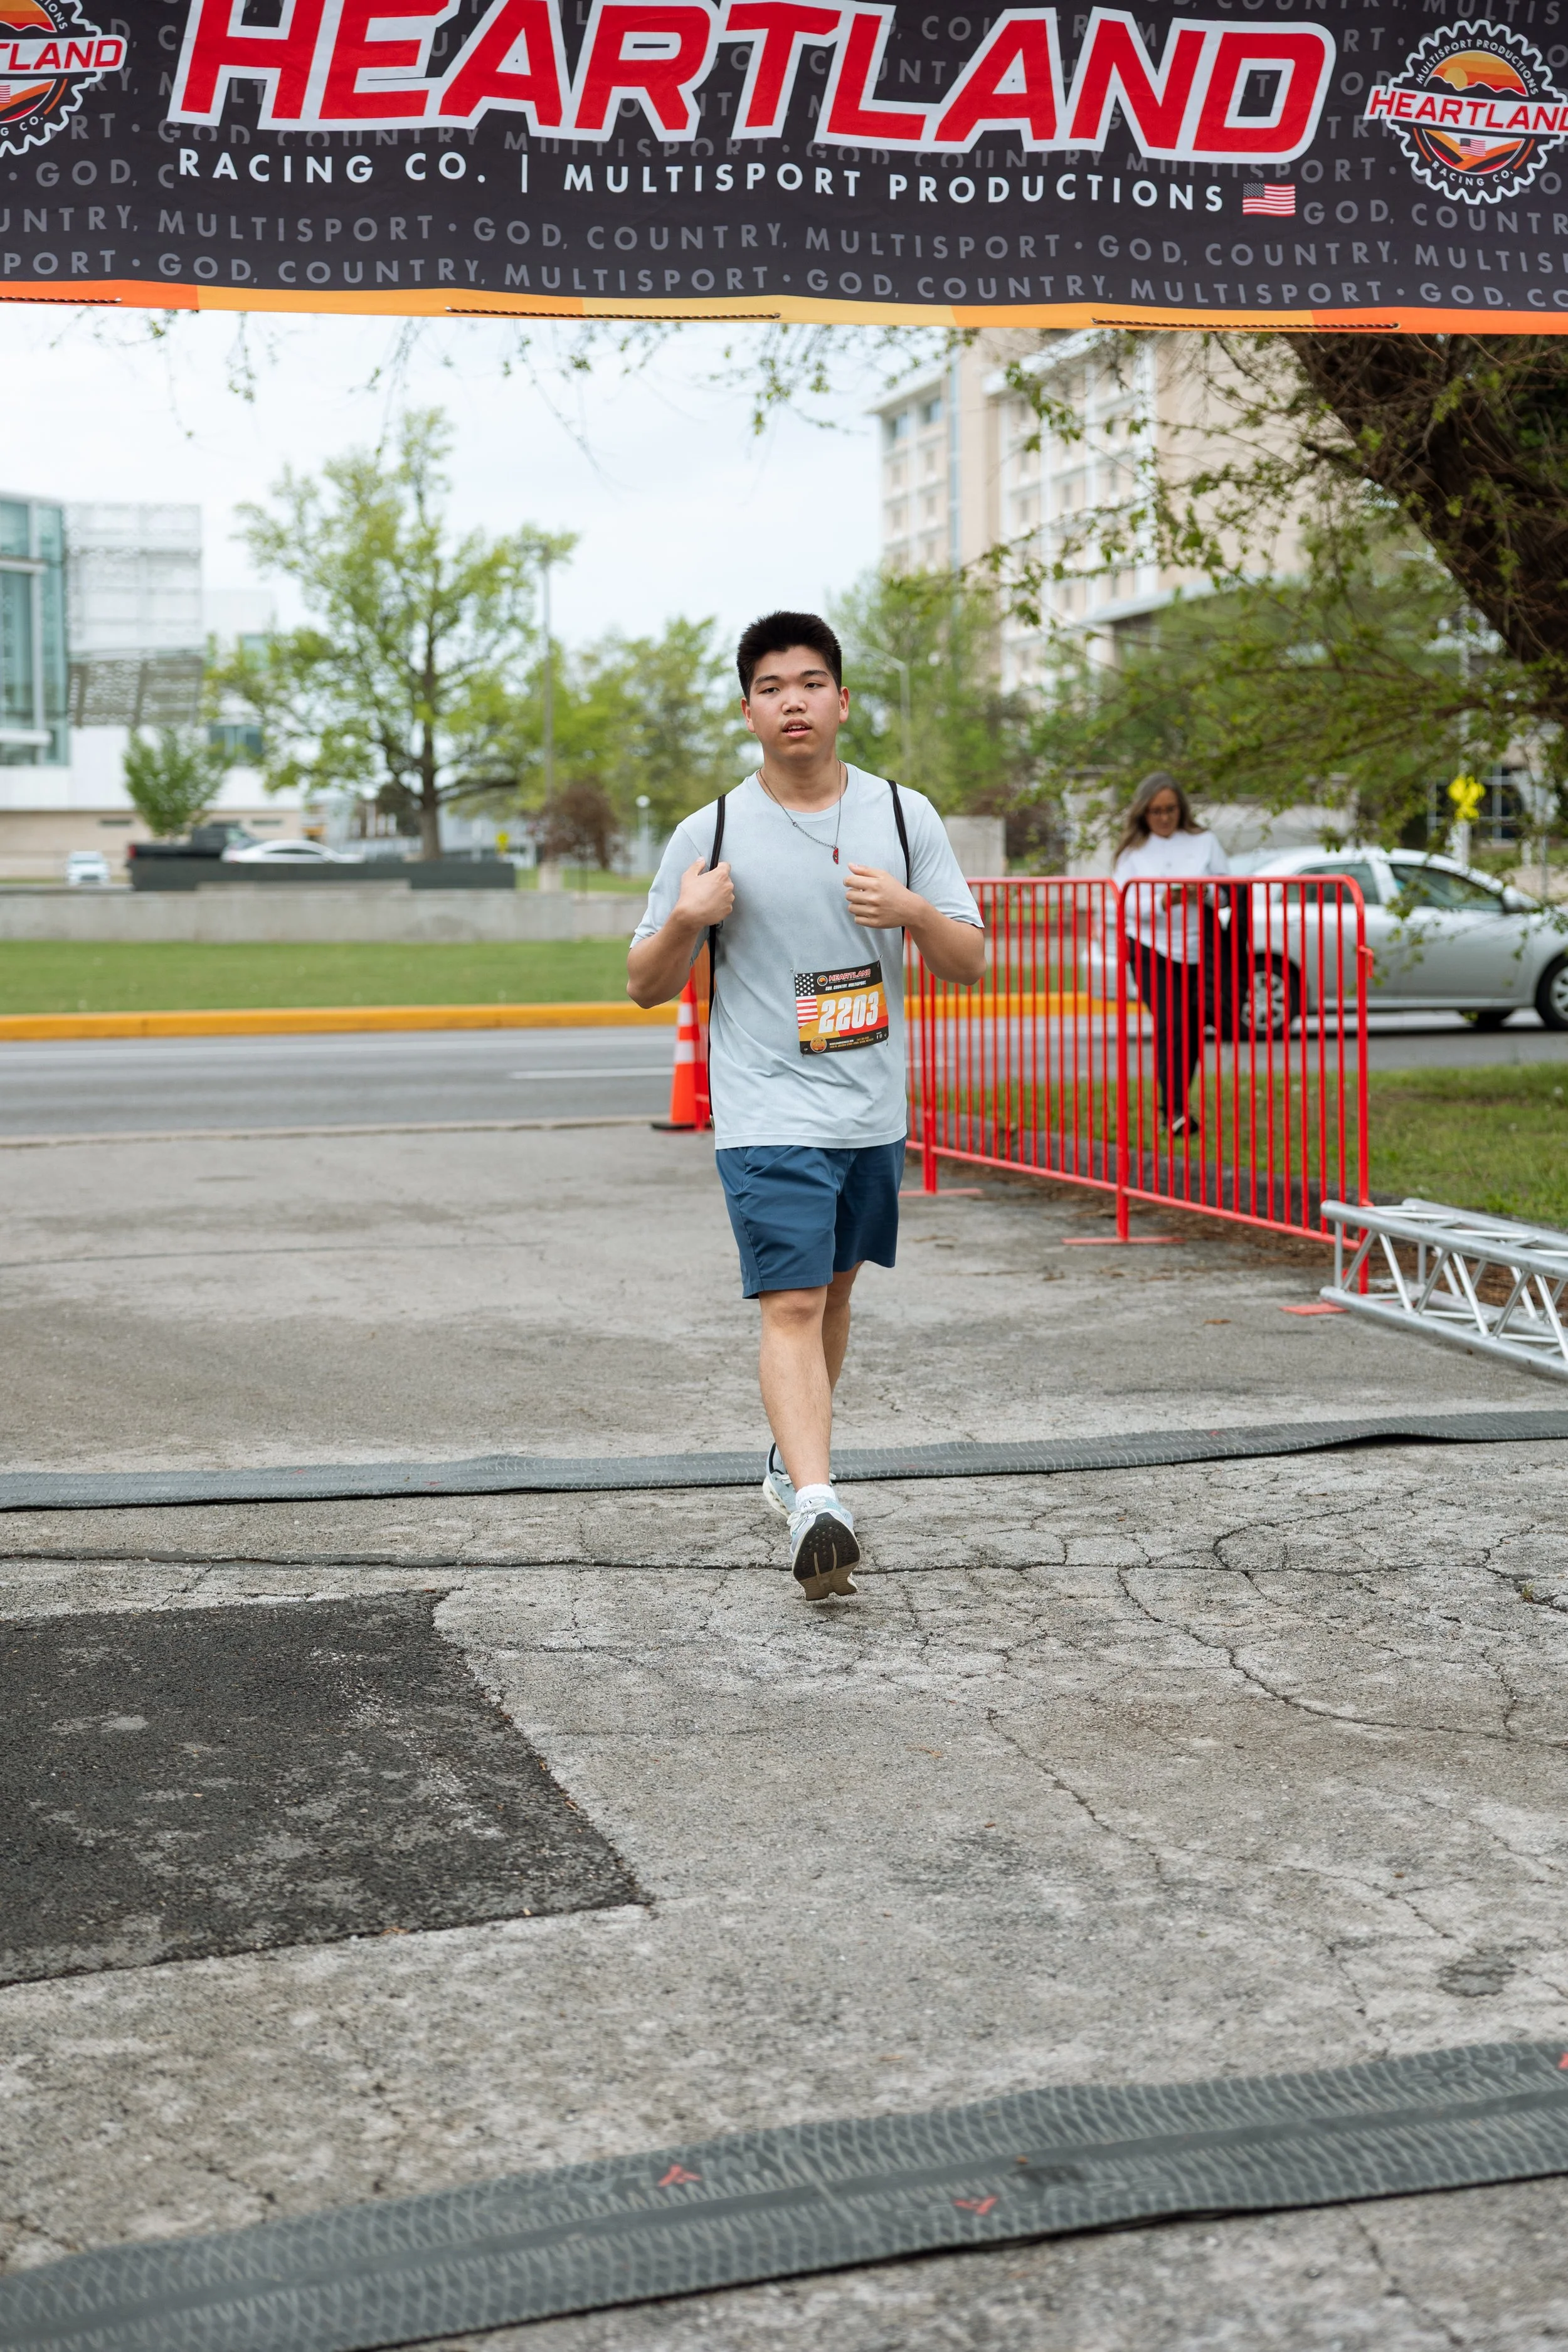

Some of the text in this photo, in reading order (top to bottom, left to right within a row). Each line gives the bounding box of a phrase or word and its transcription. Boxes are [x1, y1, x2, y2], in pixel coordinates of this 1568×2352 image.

[167, 0, 1337, 164] HEARTLAND
[1416, 39, 1472, 84] MULTISPORT
[1476, 39, 1539, 95] PRODUCTIONS
[36, 159, 137, 187] GOD,
[180, 149, 373, 183] RACING
[405, 152, 485, 183] CO.
[564, 163, 861, 196] MULTISPORT
[889, 174, 1222, 212] PRODUCTIONS
[1432, 160, 1513, 186] RACING CO.
[1303, 199, 1394, 225] GOD,
[158, 209, 432, 242] MULTISPORT
[474, 217, 568, 250] GOD,
[587, 223, 787, 250] COUNTRY,
[805, 227, 1060, 260] MULTISPORT
[1098, 235, 1187, 265] GOD,
[1205, 241, 1397, 266] COUNTRY,
[158, 253, 257, 283] GOD,
[278, 258, 485, 284] COUNTRY,
[504, 263, 768, 292] MULTISPORT
[807, 269, 899, 299] GOD,
[917, 275, 1113, 299] COUNTRY,
[1131, 278, 1381, 304] MULTISPORT
[829, 968, 871, 982] HEARTLAND
[818, 991, 879, 1034] 2203
